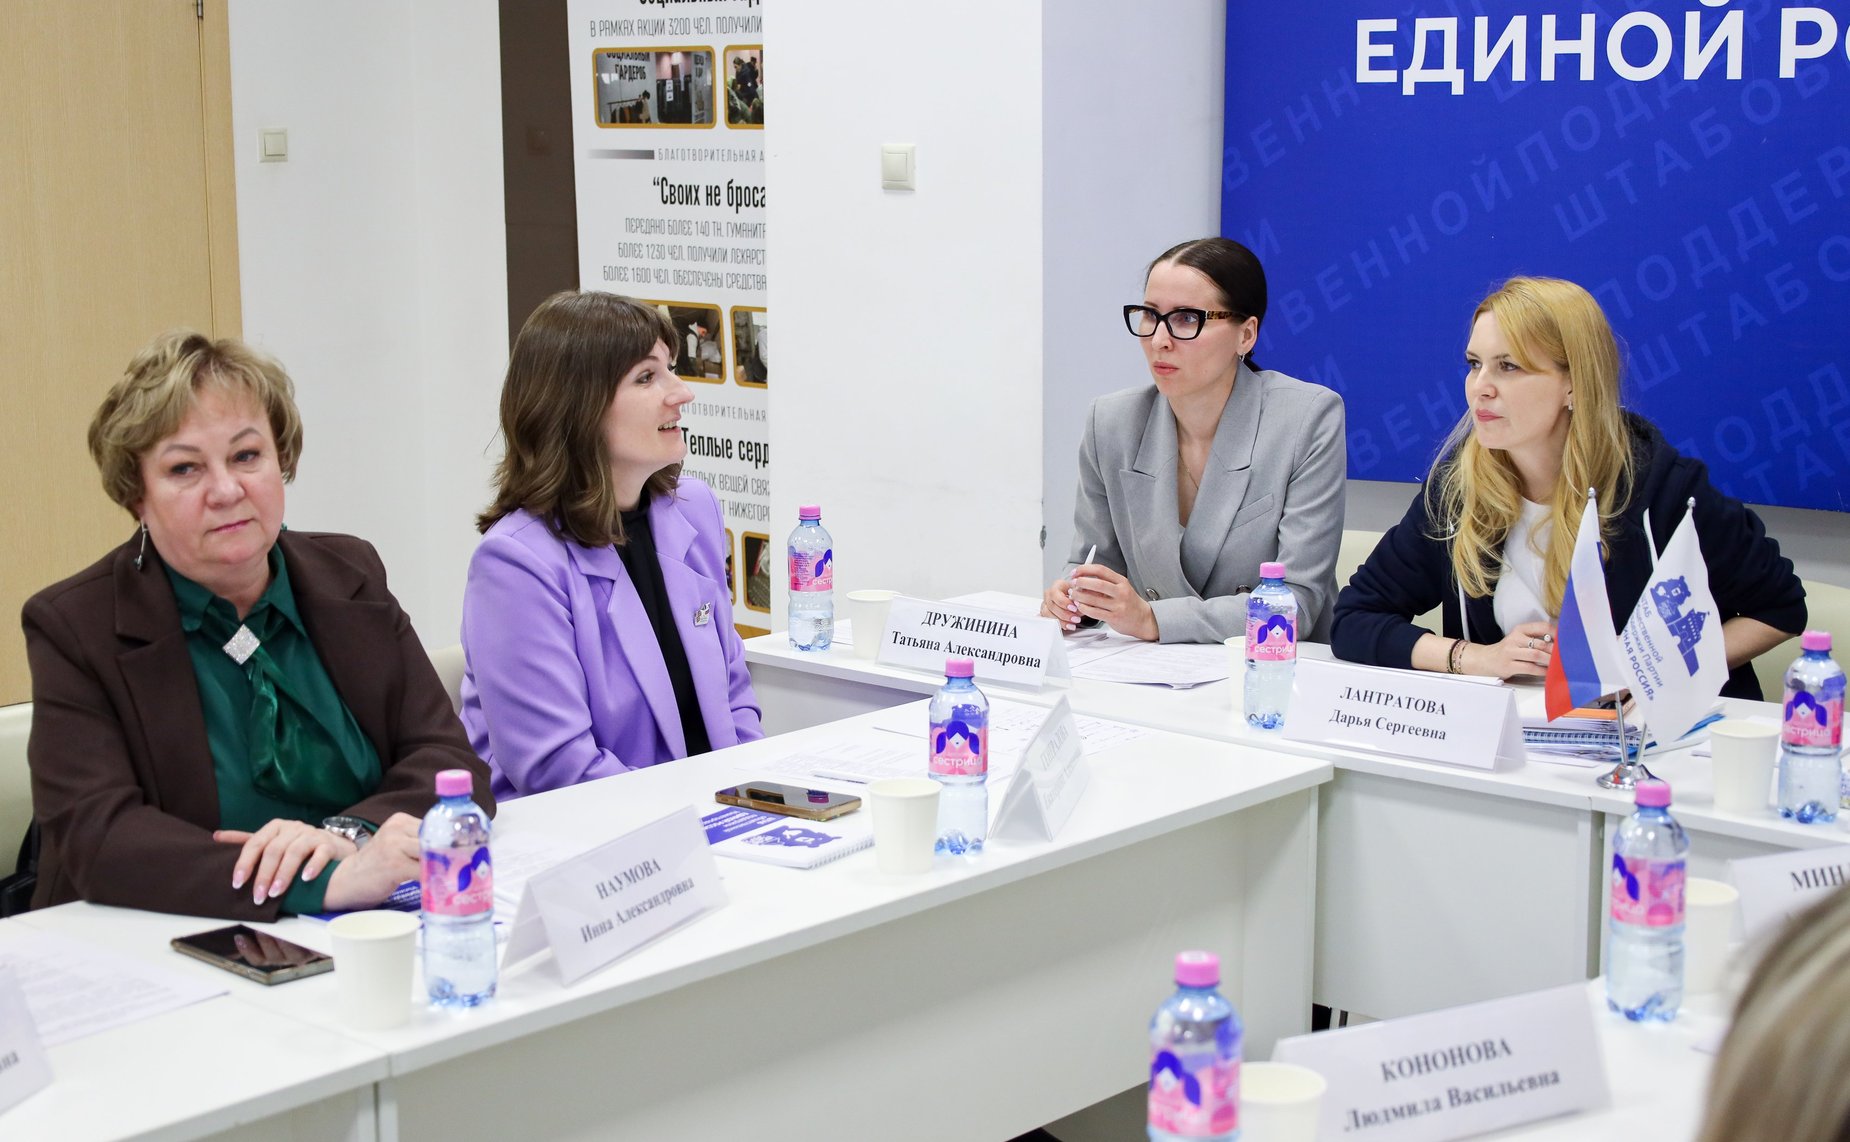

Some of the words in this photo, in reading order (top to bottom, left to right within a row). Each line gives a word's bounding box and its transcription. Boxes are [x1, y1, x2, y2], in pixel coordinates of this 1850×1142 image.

[590, 20, 597, 38] В
[599, 19, 635, 37] РАМКАХ
[637, 18, 666, 37] АКЦИИ
[668, 17, 691, 36] 3200
[694, 16, 713, 35] ЧЕЛ.
[716, 15, 763, 34] ПОЛУЧИЛИ
[1356, 0, 1743, 95] ЕДИНОЙ
[1779, 6, 1850, 80] Р
[658, 149, 756, 163] БЛАГОТВОРИТЕЛЬНАЯ
[706, 185, 721, 206] не
[625, 217, 666, 235] ПЕРЕДАНО
[668, 218, 693, 236] БОЛЕЕ
[695, 220, 710, 237] 140
[618, 242, 644, 259] БОЛЕЕ
[646, 244, 666, 261] 1230
[667, 245, 685, 262] ЧЕЛ.
[687, 245, 728, 264] ПОЛУЧИЛИ
[603, 265, 630, 282] БОЛЕЕ
[632, 267, 651, 284] 1600
[653, 268, 671, 285] ЧЕЛ.
[673, 269, 724, 289] ОБЕСПЕЧЕНЫ
[720, 473, 748, 494] ВЕЩЕЙ
[921, 610, 1018, 639] ДРУЖИНИНА
[892, 630, 941, 652] Татьяна
[943, 640, 1041, 669] Александровна
[1339, 686, 1447, 716] ЛАНТРАТОВА
[1329, 709, 1372, 731] Дарья
[1375, 716, 1447, 741] Сергеевна
[595, 858, 662, 900] НАУМОВА
[580, 918, 615, 943] Инна
[616, 877, 695, 926] Александровна
[1380, 1037, 1513, 1084] КОНОНОВА
[1343, 1096, 1443, 1134] Людмила
[1447, 1069, 1561, 1109] Васильевна
